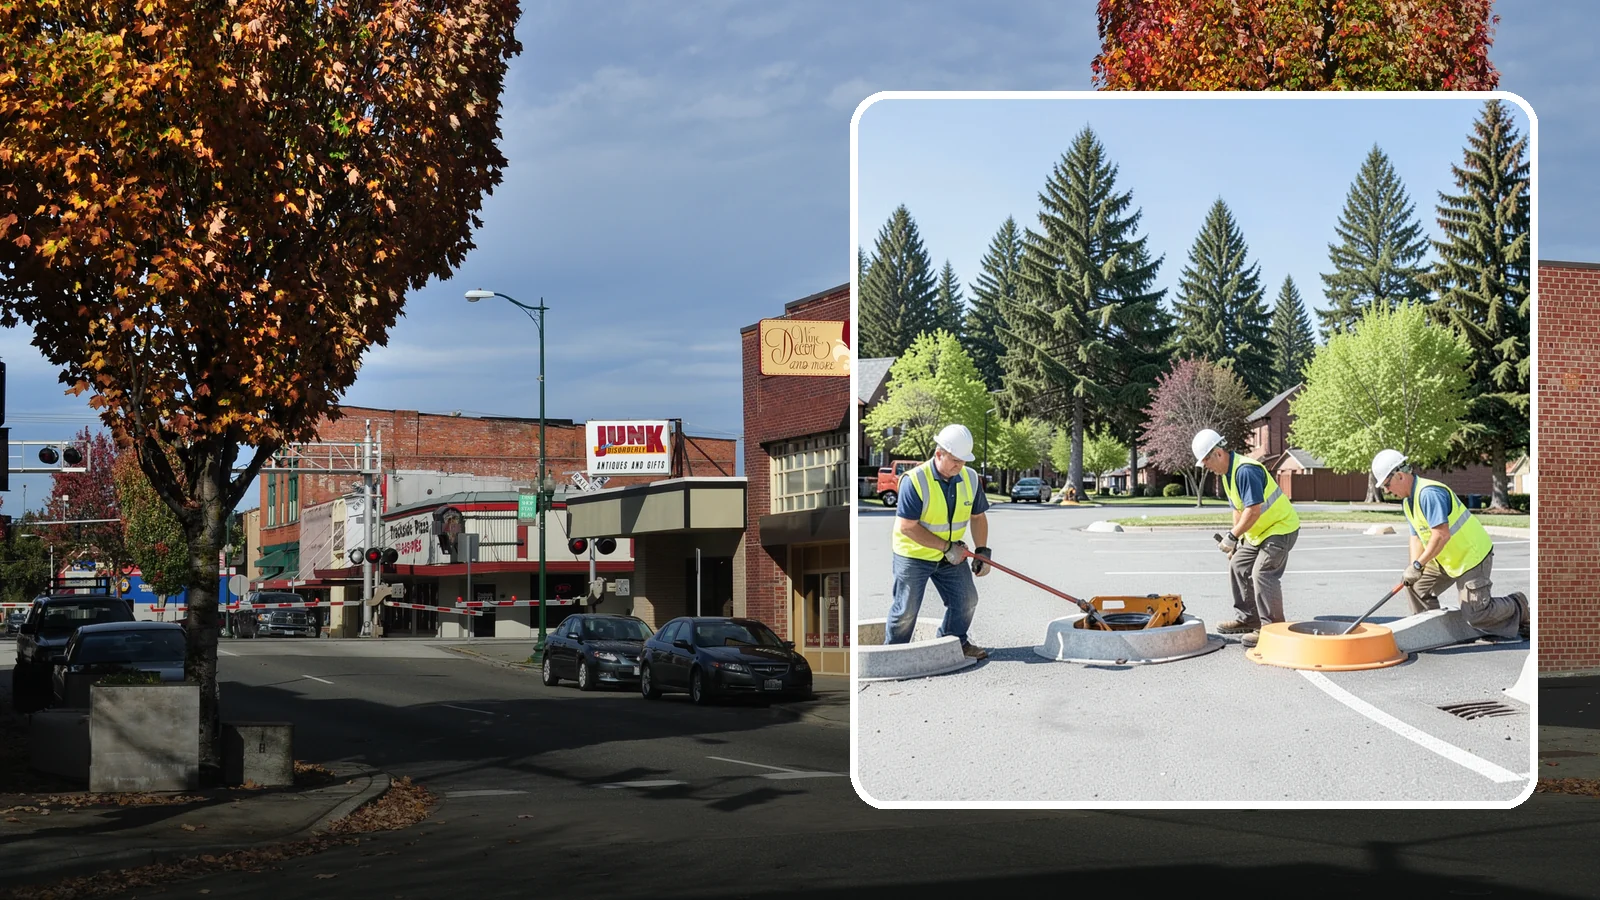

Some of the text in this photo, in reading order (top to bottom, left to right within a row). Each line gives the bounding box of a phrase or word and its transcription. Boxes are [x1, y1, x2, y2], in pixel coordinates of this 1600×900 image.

[791, 325, 821, 344] Wine
[765, 328, 831, 365] Decor
[595, 425, 666, 457] JUNK
[607, 446, 646, 454] DISORDERLY
[596, 461, 665, 470] ANTIQUES AND GIFTS
[414, 519, 429, 535] Pizza
